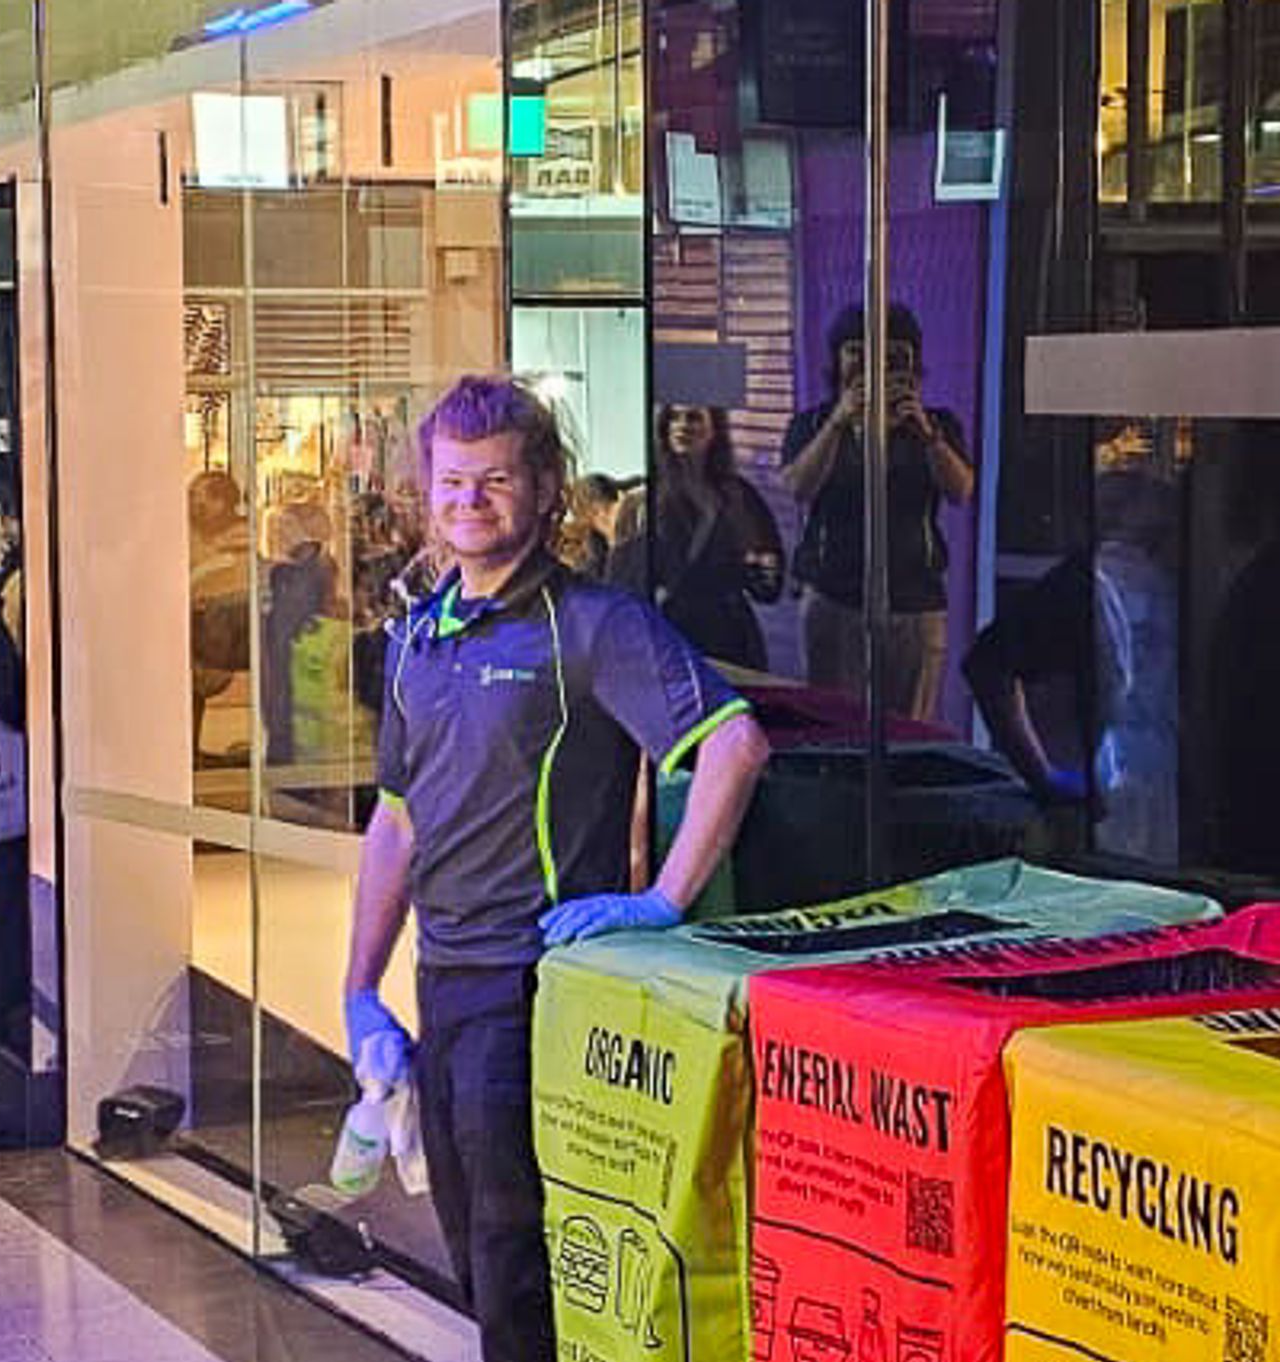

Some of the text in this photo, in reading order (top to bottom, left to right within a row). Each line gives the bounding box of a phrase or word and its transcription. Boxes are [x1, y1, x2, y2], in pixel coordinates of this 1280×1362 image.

[585, 1026, 676, 1105] ORGANIC
[763, 1040, 955, 1153] ENERAL WAST
[1046, 1126, 1240, 1266] RECYCLING
